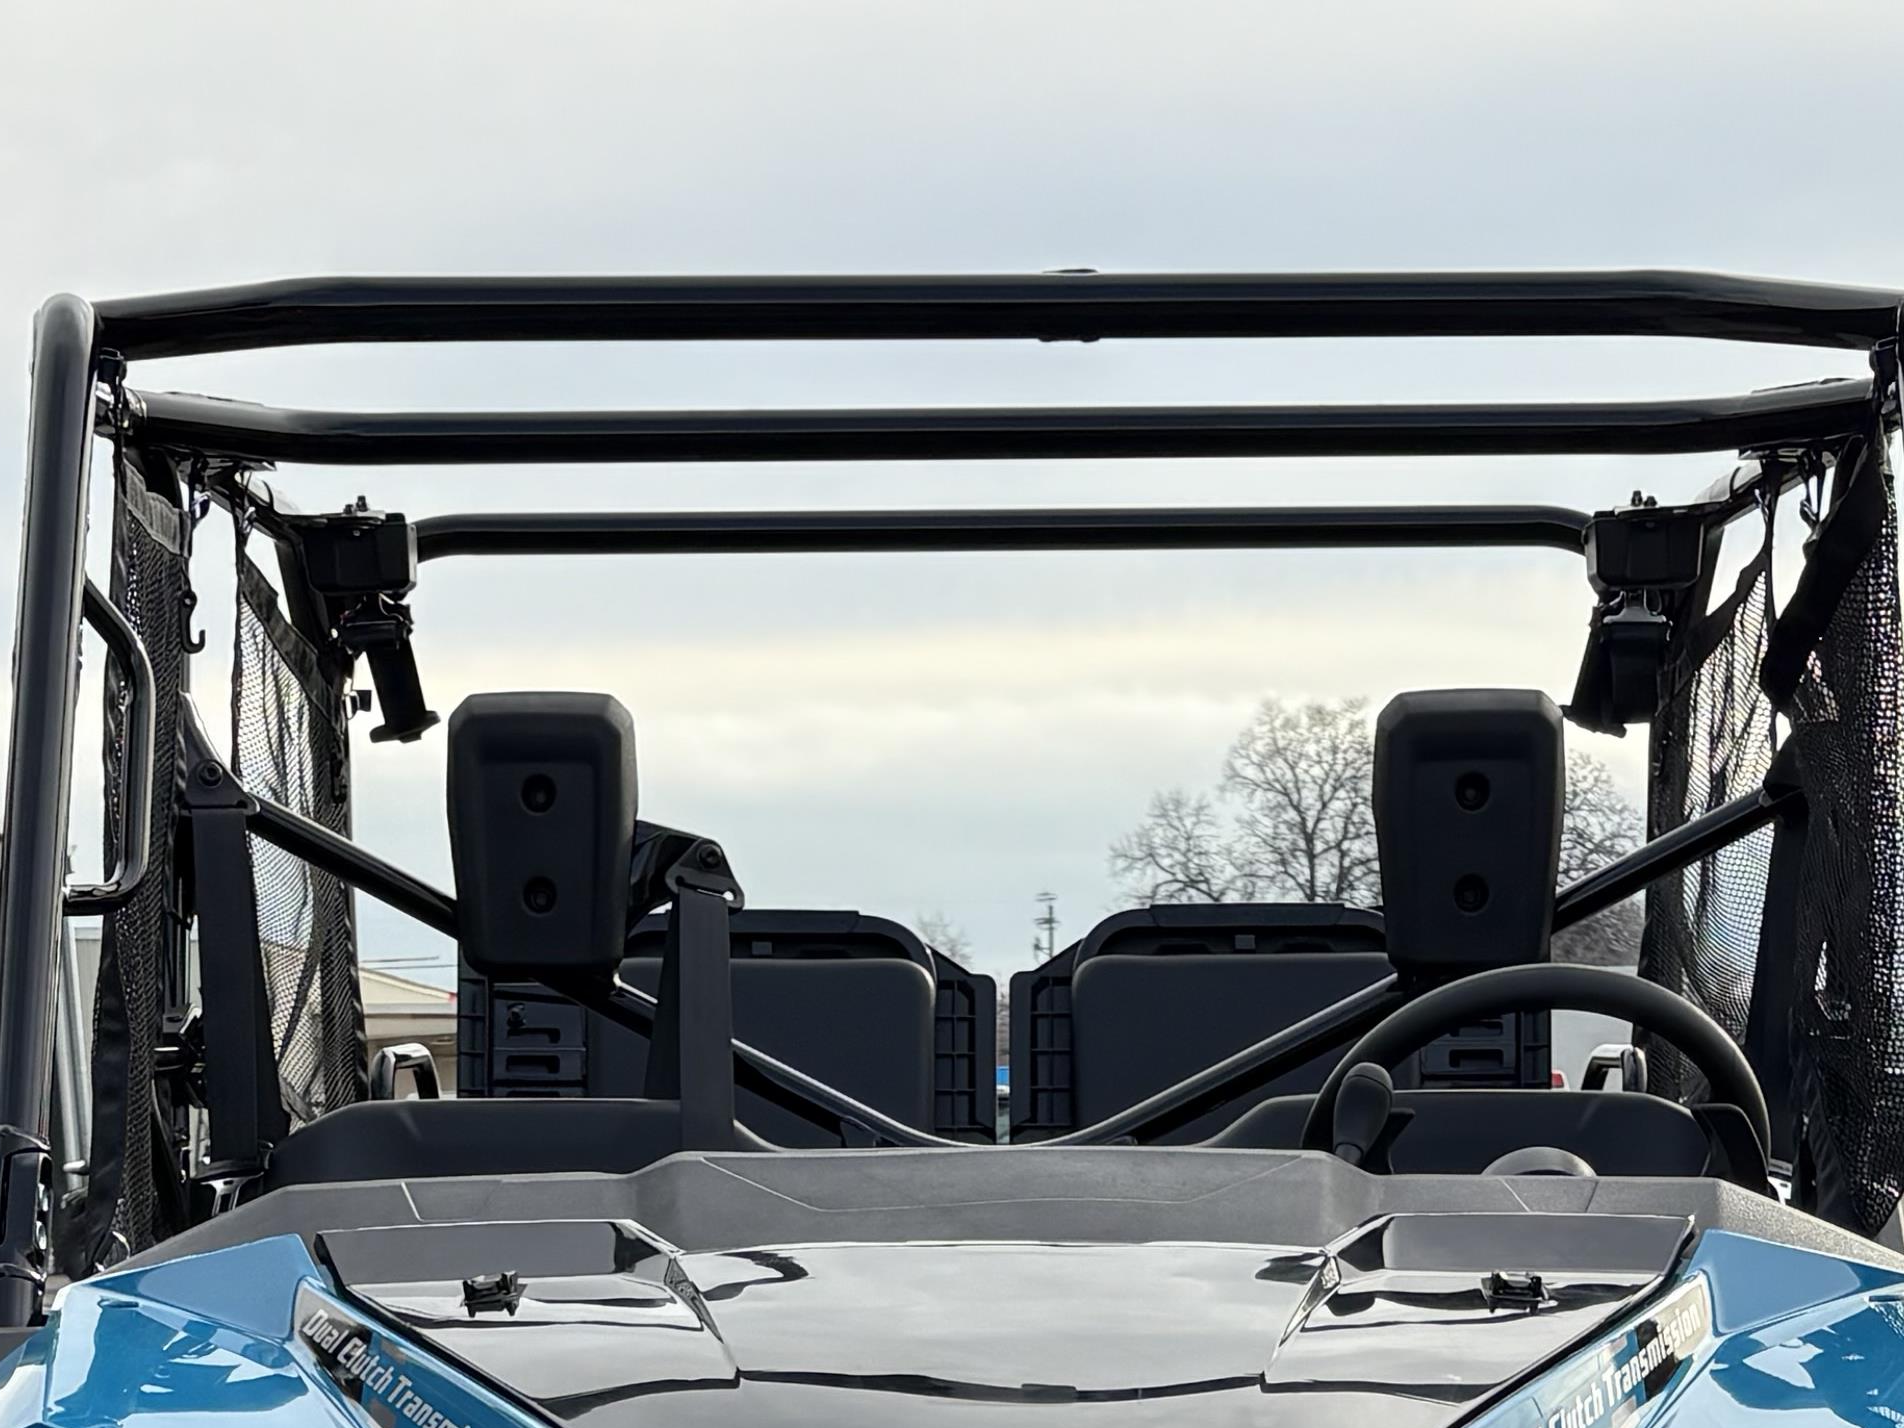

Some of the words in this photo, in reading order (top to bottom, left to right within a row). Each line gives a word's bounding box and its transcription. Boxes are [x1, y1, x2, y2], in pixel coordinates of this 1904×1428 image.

[302, 1308, 349, 1354] Dual
[336, 1336, 395, 1395] Clutch
[1601, 1302, 1702, 1407] Transmission
